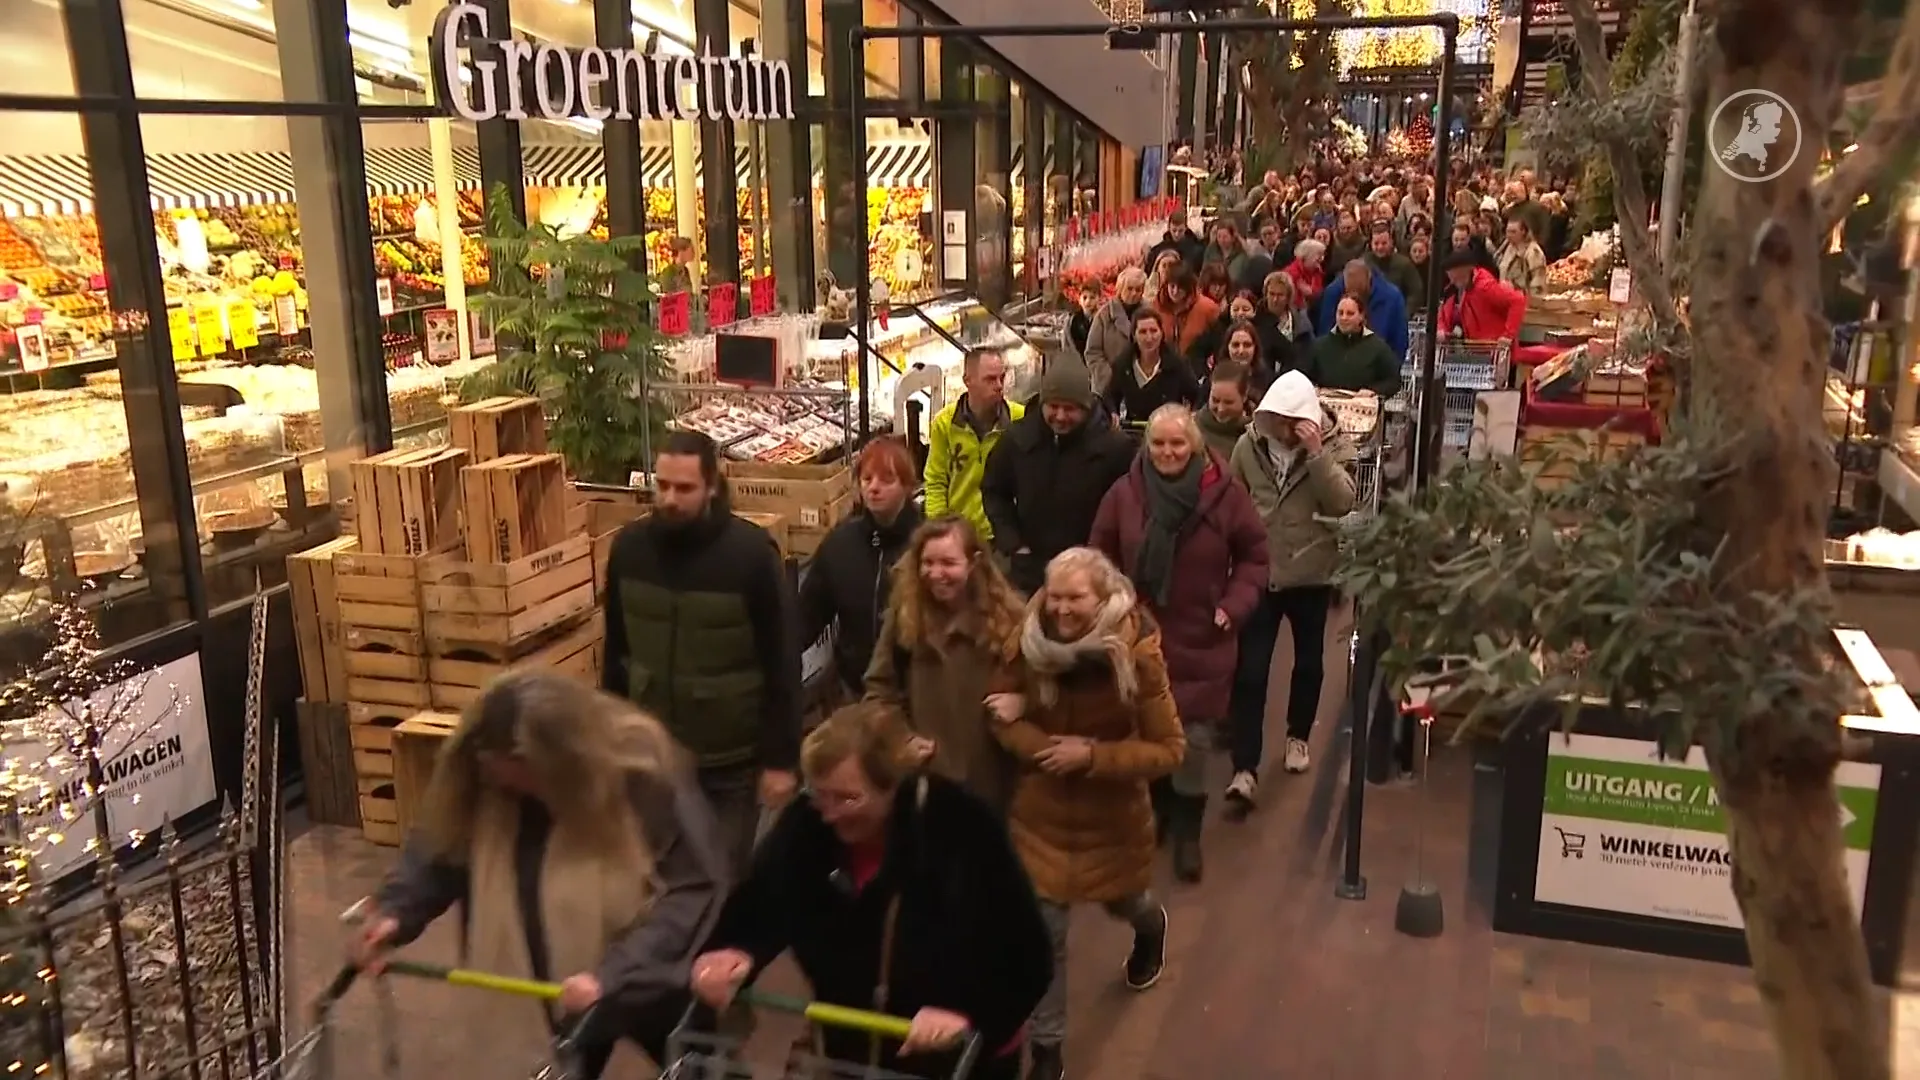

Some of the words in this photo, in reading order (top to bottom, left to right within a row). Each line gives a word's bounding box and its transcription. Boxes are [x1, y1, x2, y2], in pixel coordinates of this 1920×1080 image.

[441, 2, 797, 122] Groentetuin
[410, 516, 423, 556] STOR
[1565, 770, 1682, 802] UITGANG
